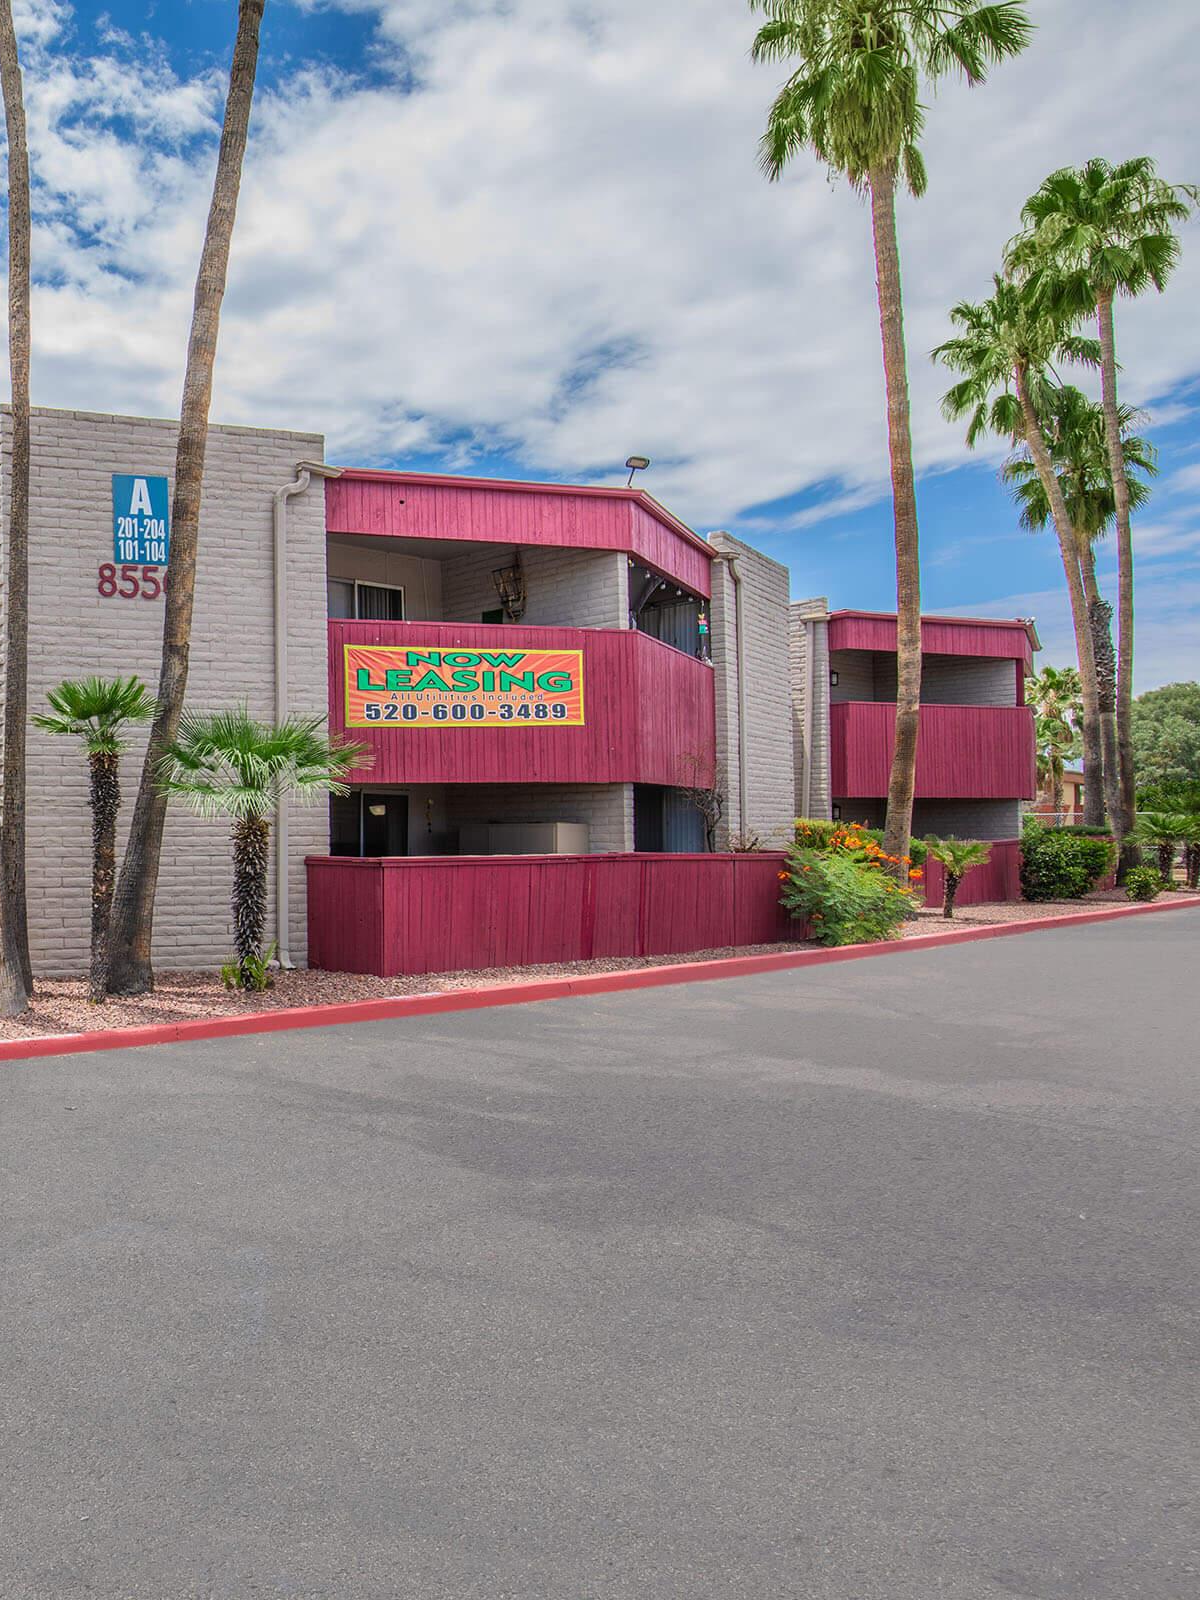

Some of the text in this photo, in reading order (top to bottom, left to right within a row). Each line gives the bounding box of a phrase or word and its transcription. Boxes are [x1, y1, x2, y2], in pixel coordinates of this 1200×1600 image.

[130, 479, 153, 515] A
[118, 517, 166, 539] 201-204
[118, 539, 166, 562] 101-104
[98, 563, 168, 600] 855
[406, 651, 526, 668] NOW
[356, 669, 573, 692] LEASING
[391, 693, 544, 702] All Utilities Included
[364, 703, 568, 721] 520-600-3489
